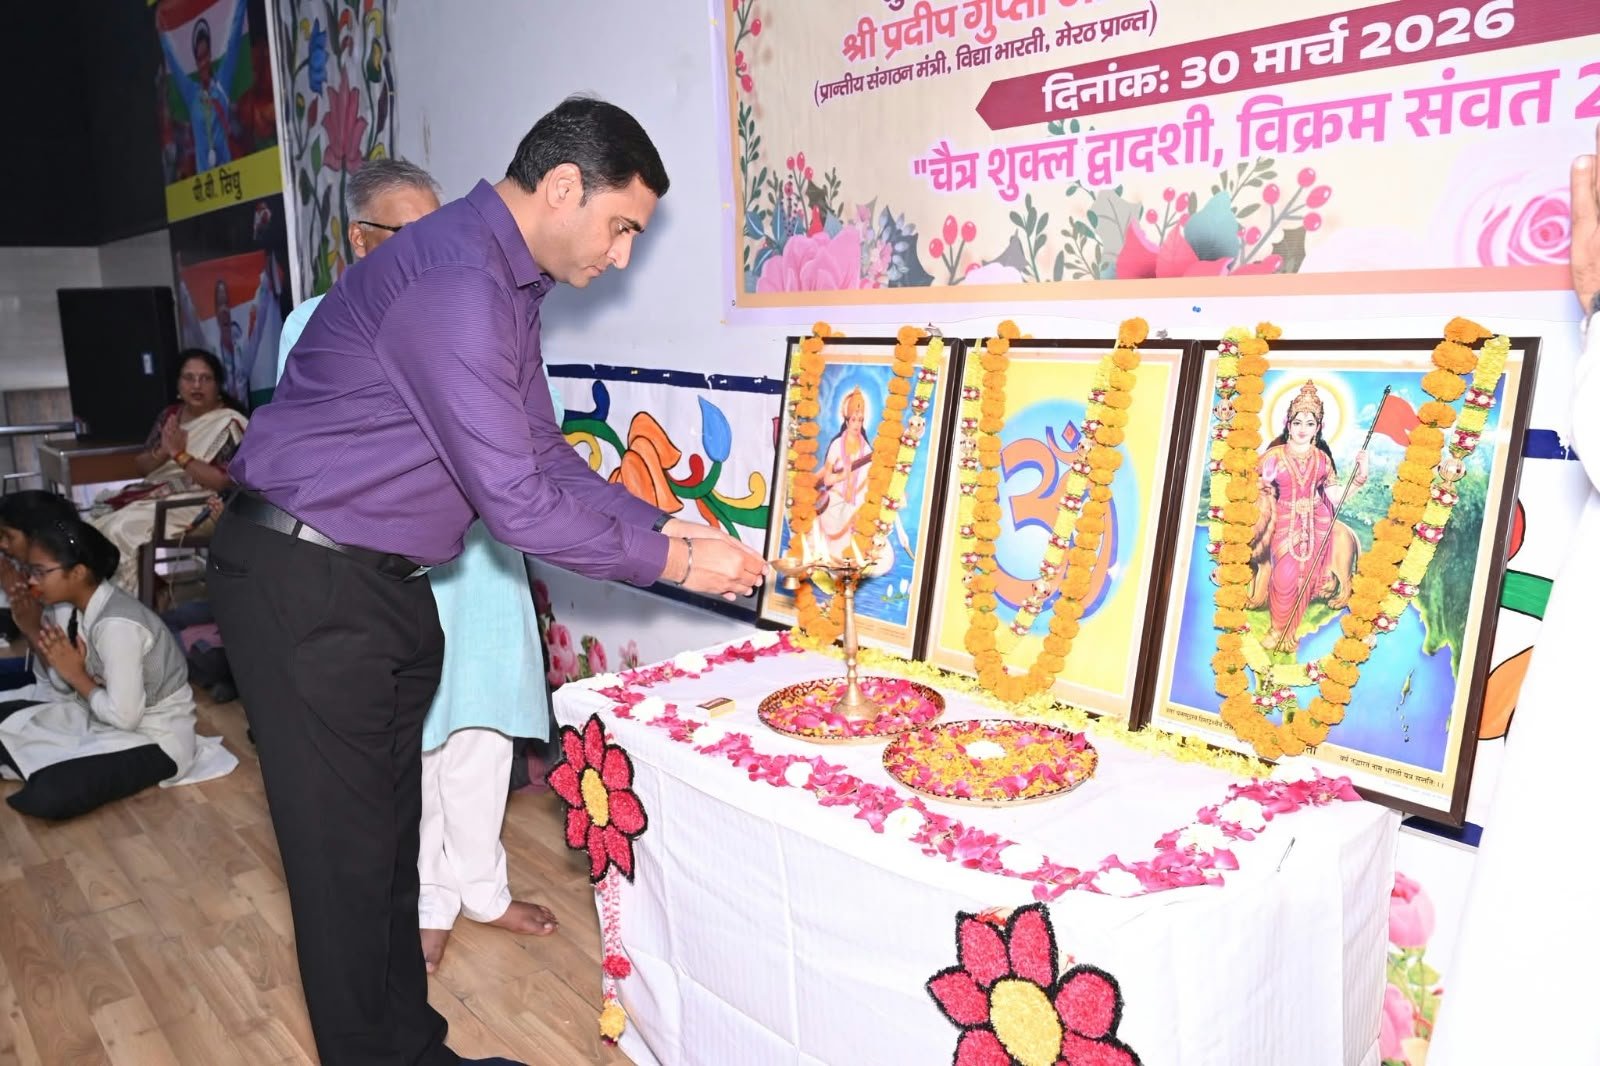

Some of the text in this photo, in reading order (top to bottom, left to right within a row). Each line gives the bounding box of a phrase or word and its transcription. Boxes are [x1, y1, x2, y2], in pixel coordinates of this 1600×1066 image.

[814, 0, 1158, 108] (प्रान्तीय संगठन मंत्री, विद्या भारती, मेरठ प्रान्त)
[842, 16, 878, 63] श्री
[882, 0, 958, 58] प्रदीप
[1041, 0, 1515, 113] दिनांक: 30 मार्च 2026
[914, 141, 980, 193] "चैत्र
[987, 137, 1078, 202] शुक्ल
[1085, 103, 1224, 187] द्वादशी,
[1236, 94, 1393, 157] विक्रम
[1403, 67, 1560, 138] संवत
